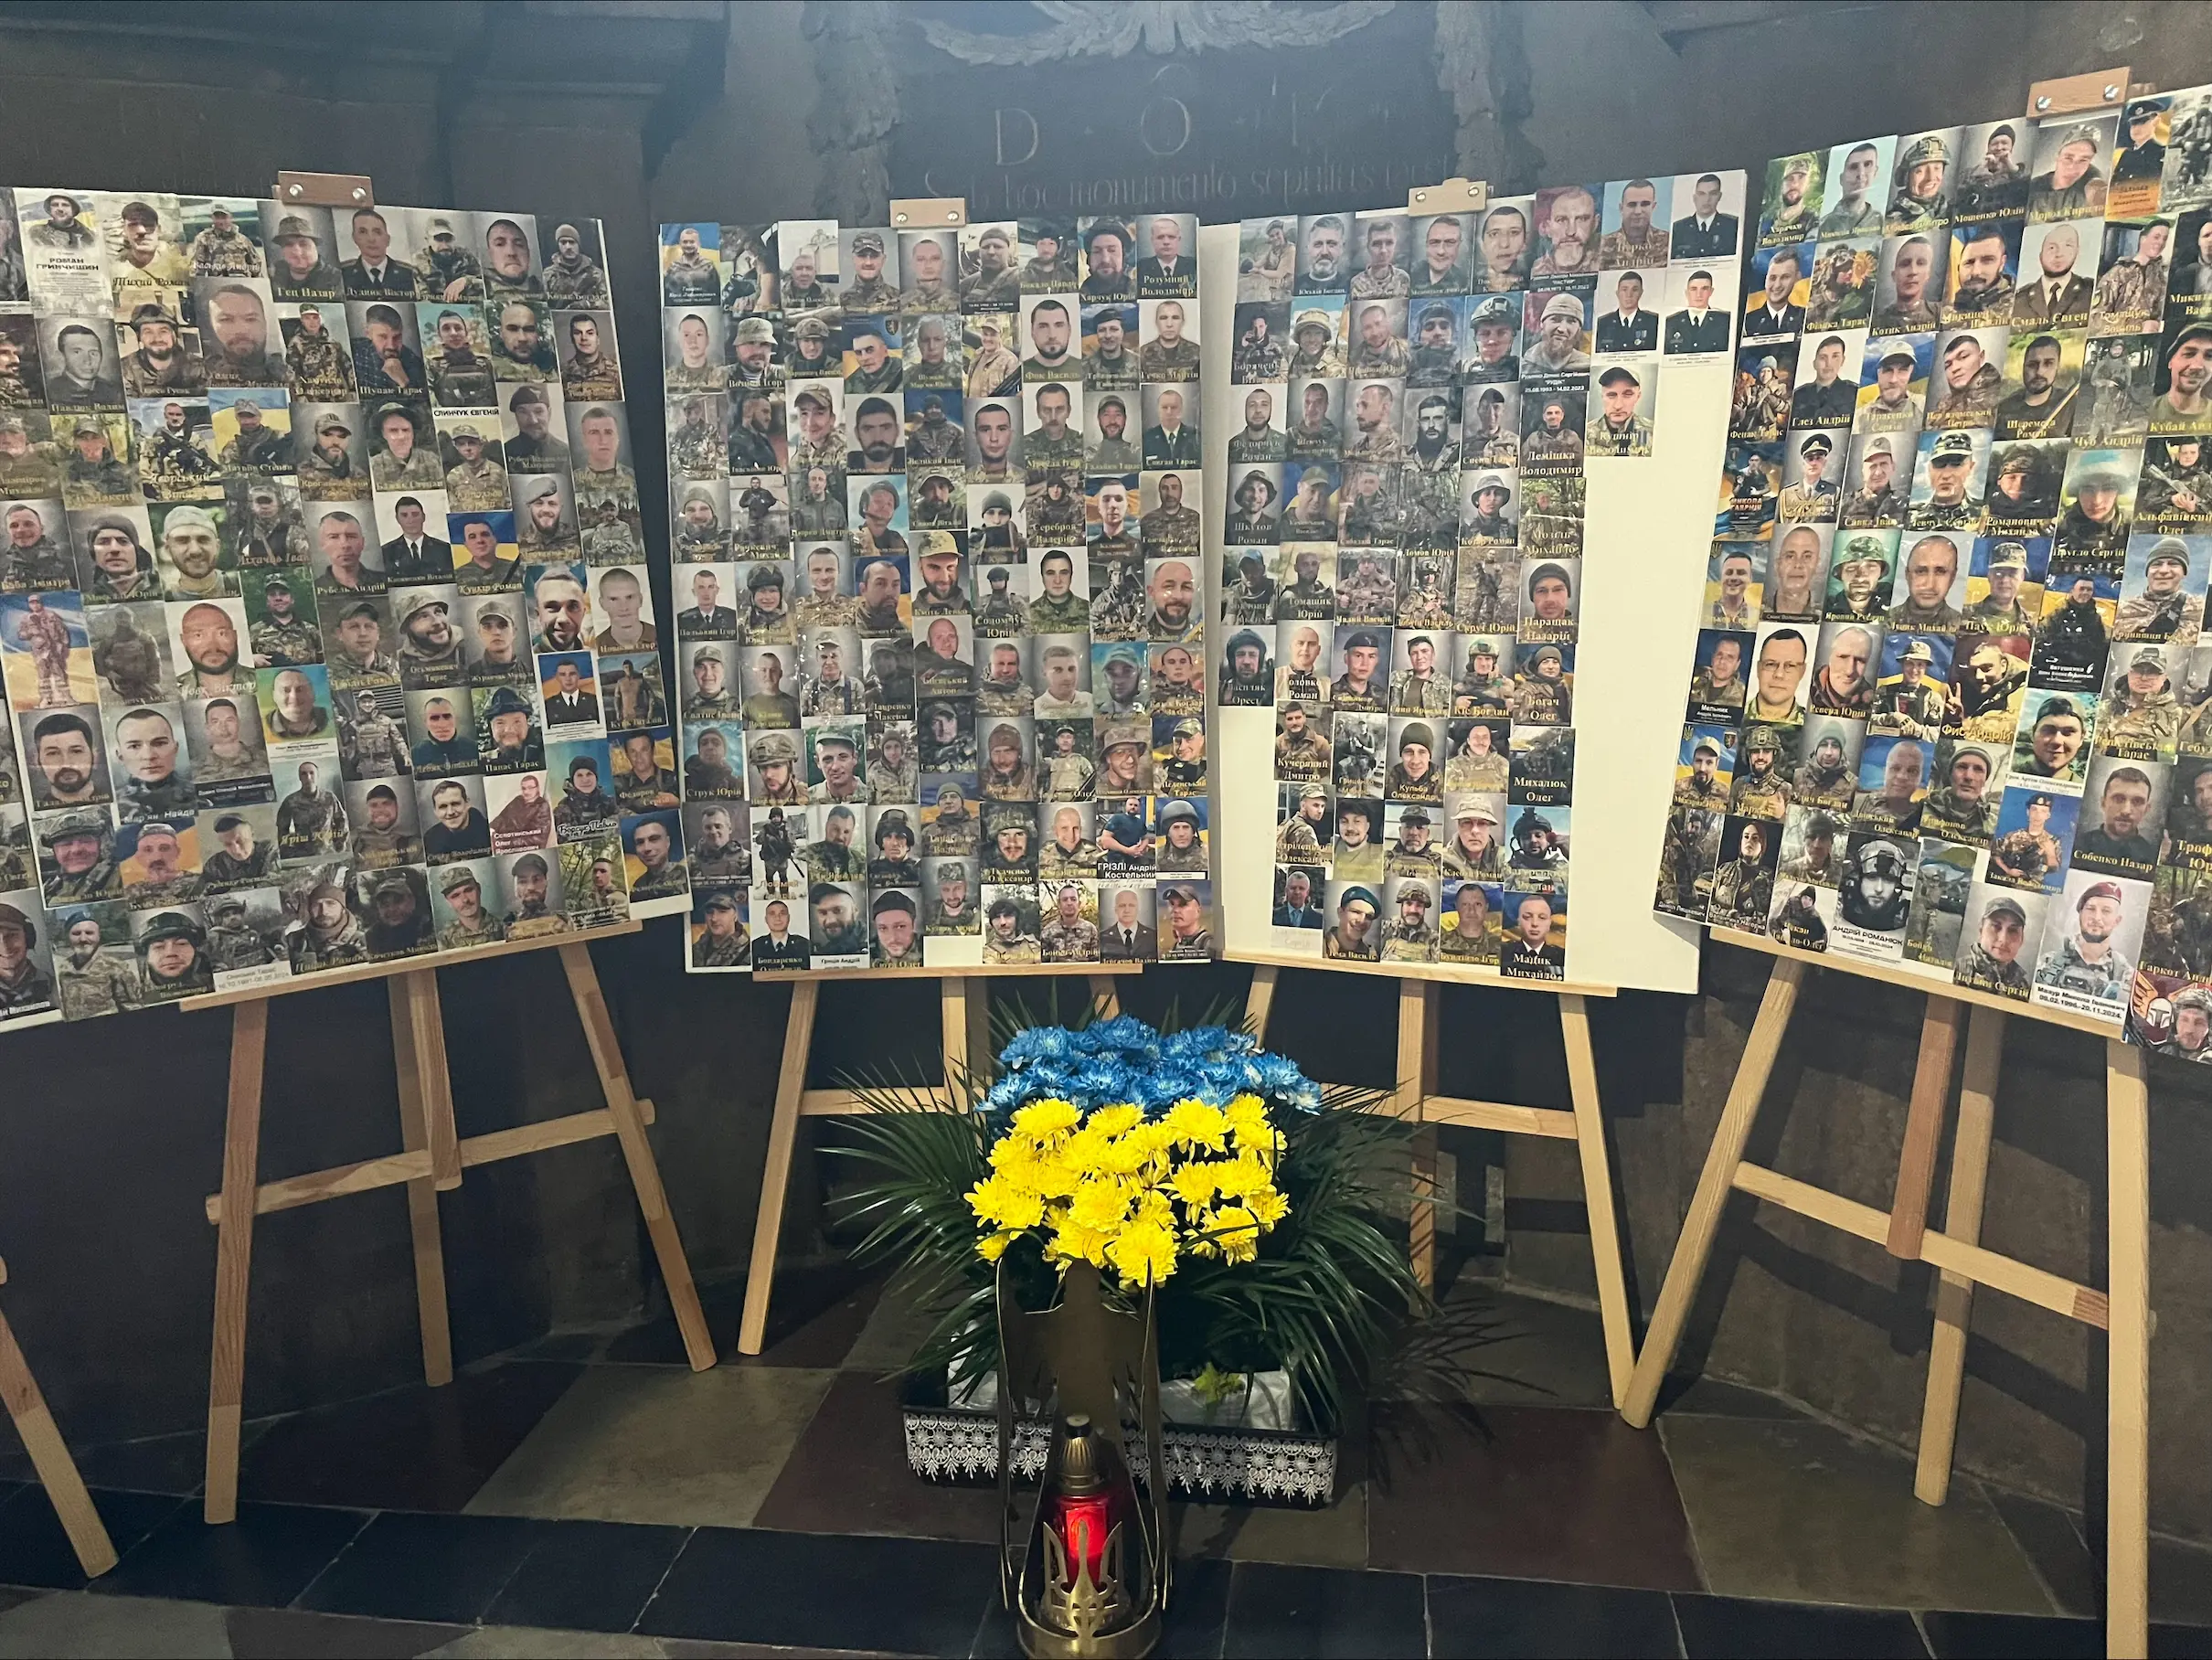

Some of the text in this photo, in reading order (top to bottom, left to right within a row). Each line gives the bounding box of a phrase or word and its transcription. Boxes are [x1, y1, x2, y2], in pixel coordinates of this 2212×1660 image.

[995, 108, 1038, 166] D
[1141, 95, 1191, 155] O
[113, 277, 153, 287] Тихий
[302, 288, 336, 301] Назар
[2052, 312, 2088, 323] Євген
[1816, 415, 1850, 426] Андрій
[2150, 421, 2187, 432] Кубай
[1526, 451, 1575, 462] Лемішка
[1519, 466, 1582, 476] Володимир
[1297, 610, 1323, 620] Юрій
[1289, 689, 1318, 700] Роман
[1530, 711, 1557, 722] Олег
[2117, 749, 2150, 761] Тарас
[515, 761, 539, 769] Тарас
[1283, 771, 1320, 782] Дмитро
[1399, 783, 1428, 793] Кульба
[1514, 777, 1568, 789] Михалюк
[686, 788, 742, 798] Струк Юрій
[1526, 791, 1553, 803] Олег
[164, 809, 195, 819] Найда
[1097, 862, 1156, 872] ГРІЗЛІ Андрій
[2120, 857, 2154, 872] Назар
[1832, 925, 1904, 946] АНДРІЙ РОМАНЮК
[2037, 986, 2060, 997] Мазур
